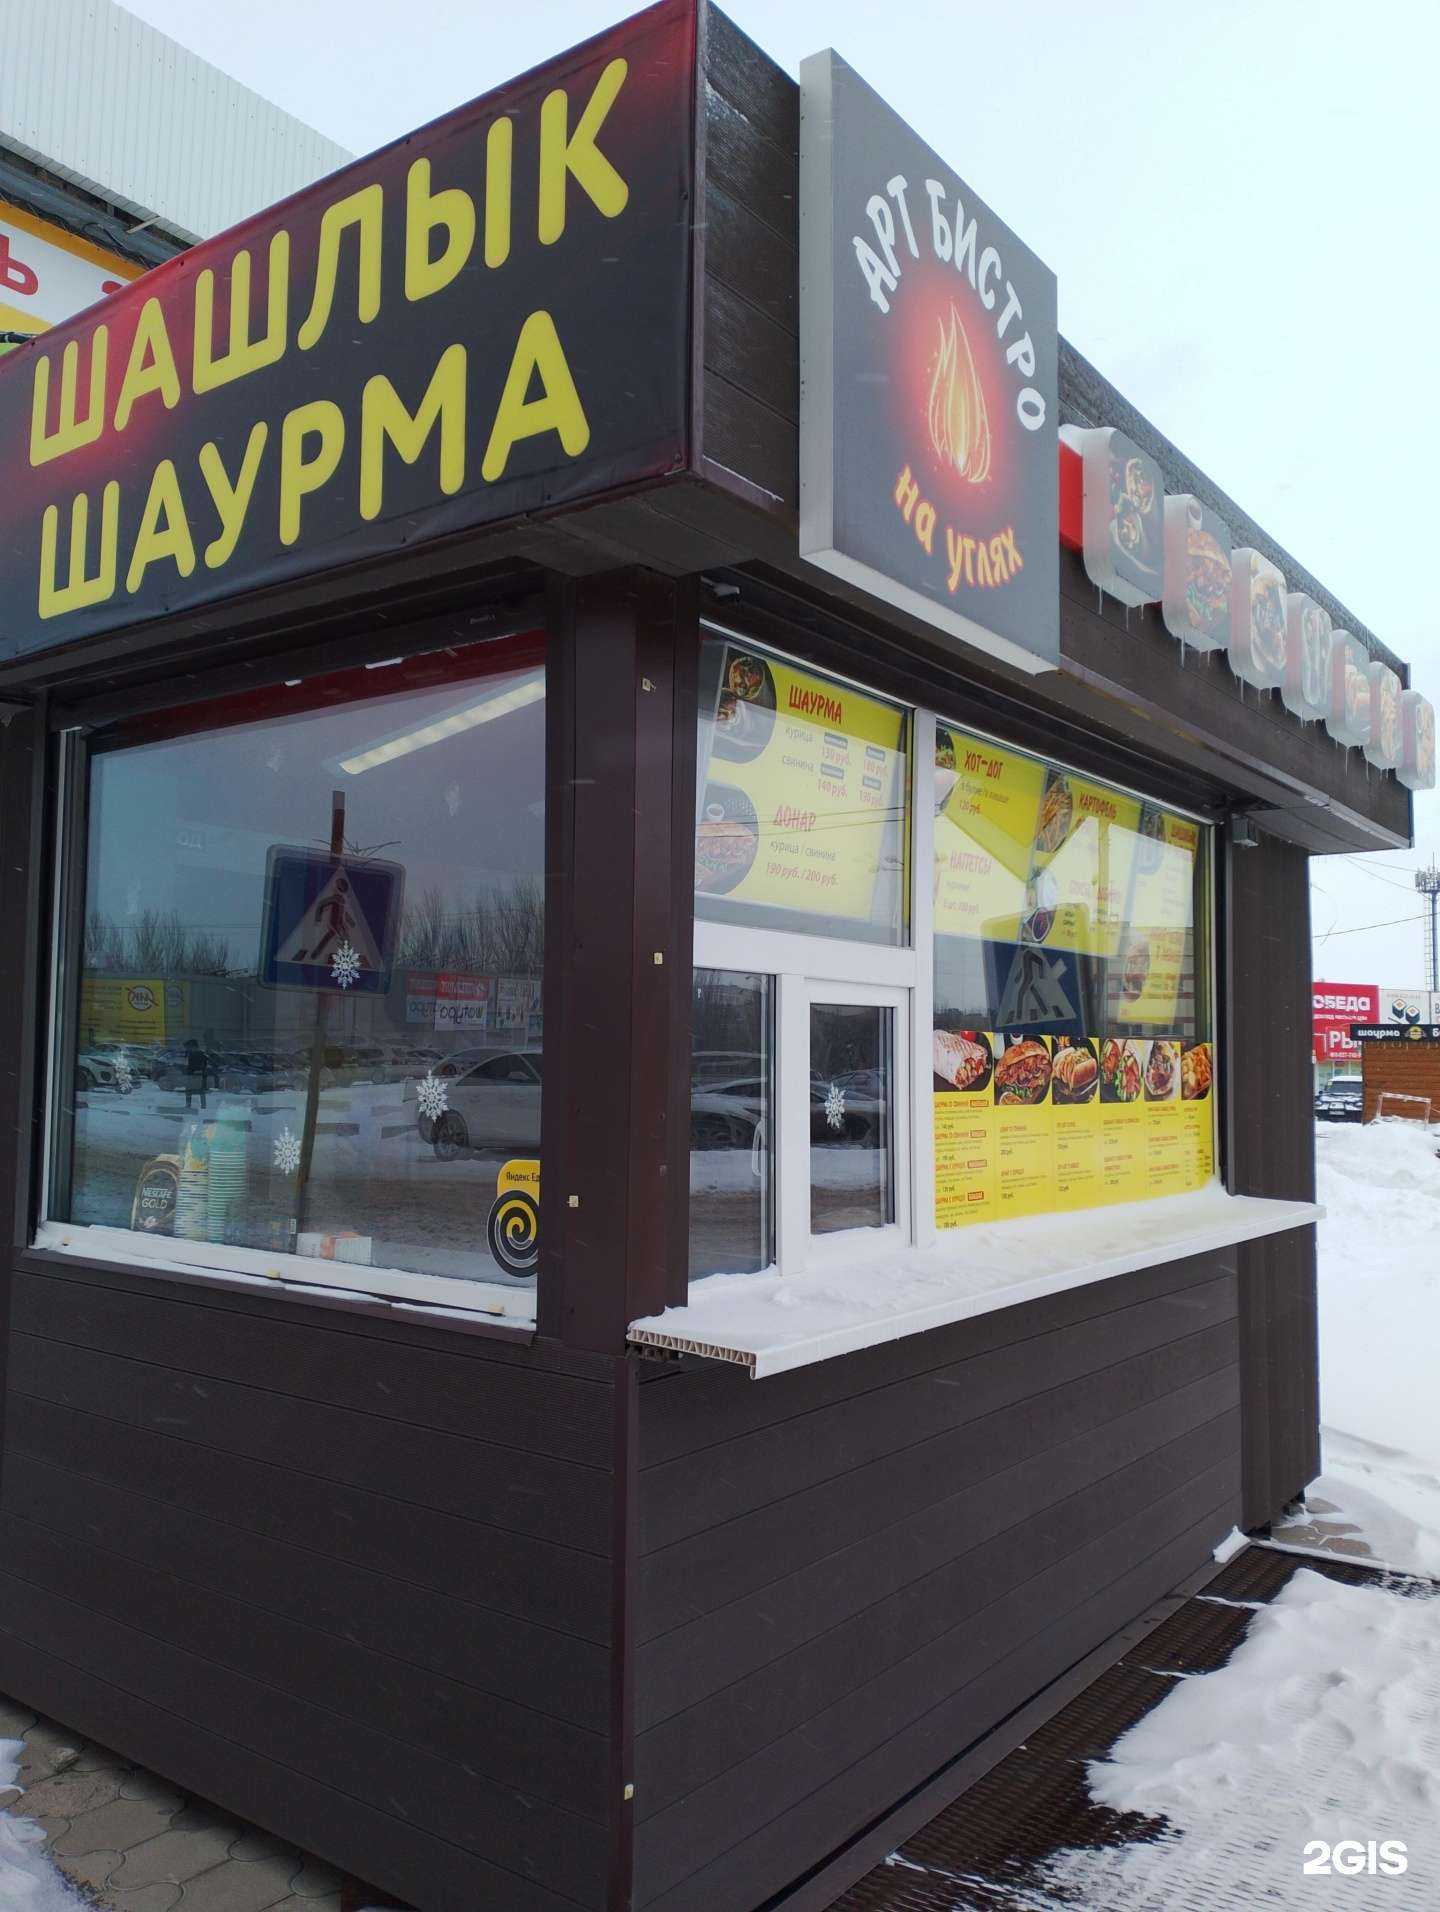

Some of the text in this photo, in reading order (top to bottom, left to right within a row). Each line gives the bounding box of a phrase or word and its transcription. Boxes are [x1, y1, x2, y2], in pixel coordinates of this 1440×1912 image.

[29, 57, 629, 467] ШАШЛЫК
[852, 174, 1046, 432] АРТ БИСТРО
[38, 310, 590, 619] ШАУРМА
[788, 684, 843, 725] ШАУРМА
[964, 750, 1004, 780] ХОТ-ДОГ
[772, 804, 817, 832] ДОНАР
[769, 840, 800, 858] курица
[1358, 1029, 1400, 1039] шаурма
[506, 1171, 531, 1182] Яндекс
[142, 1198, 168, 1209] GOLD
